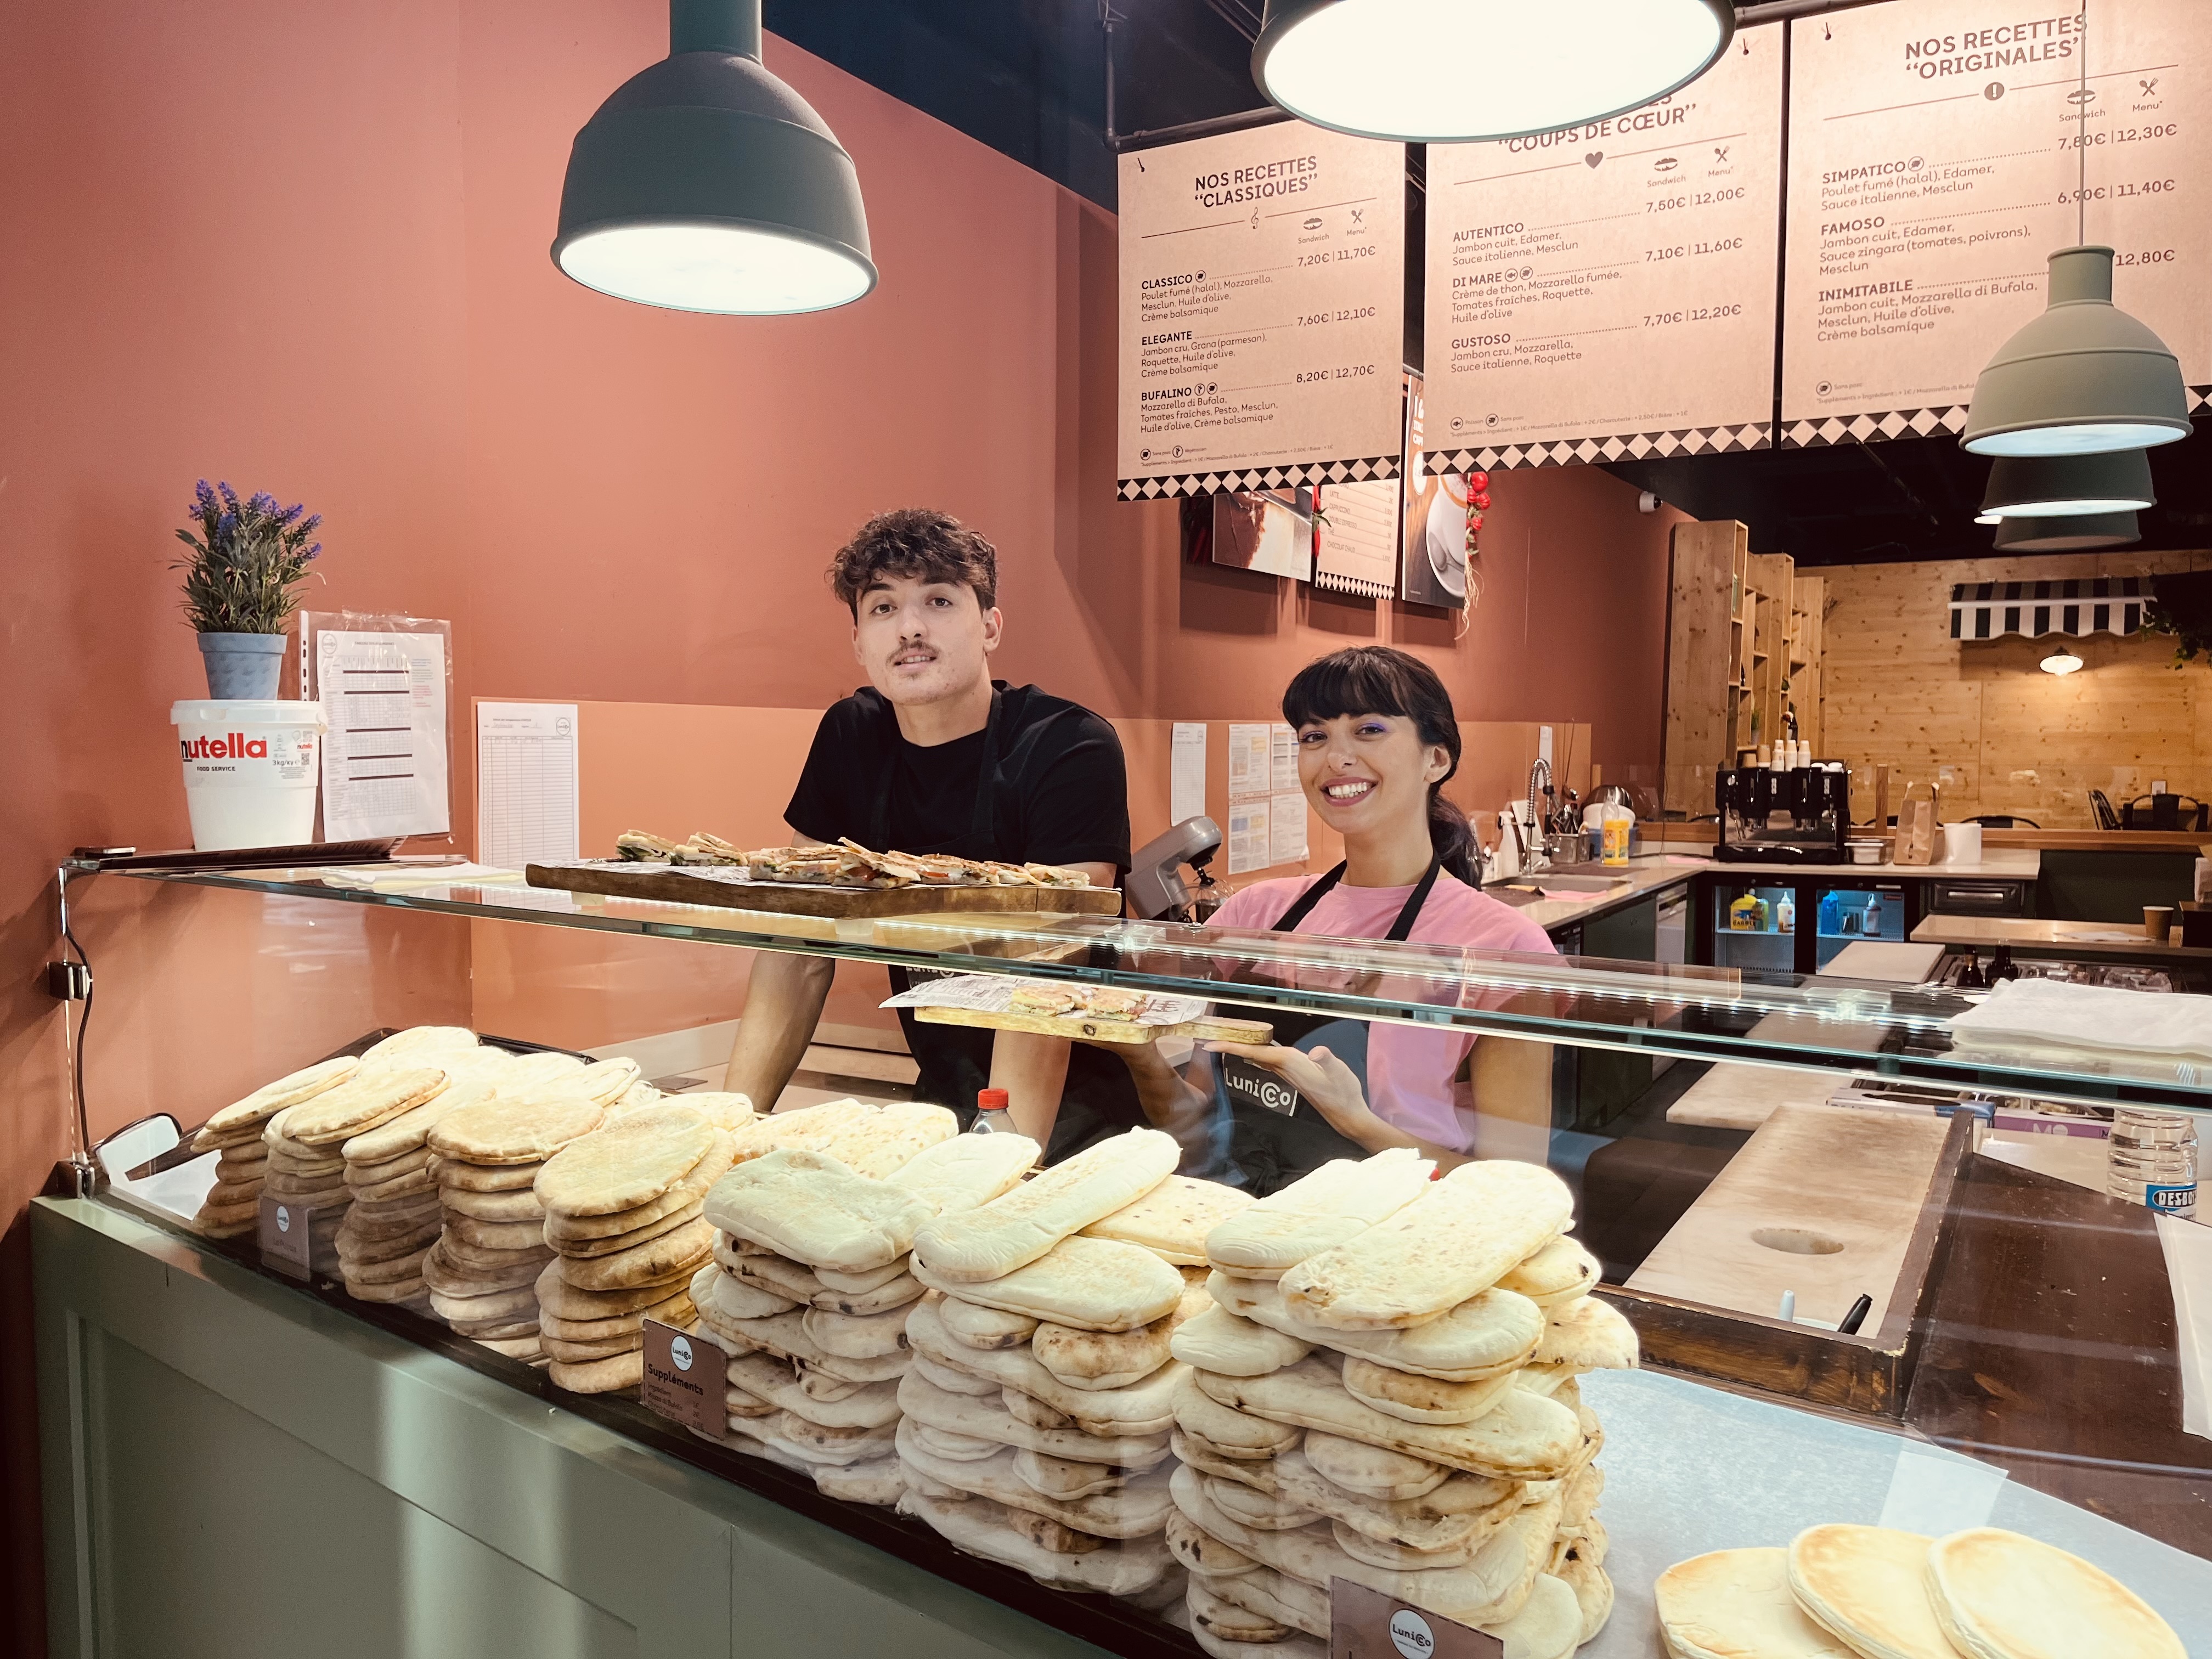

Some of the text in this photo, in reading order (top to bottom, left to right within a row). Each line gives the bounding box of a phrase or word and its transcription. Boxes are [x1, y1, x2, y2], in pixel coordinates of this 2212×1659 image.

[1905, 14, 2087, 60] NOS RECETTES
[1585, 121, 1612, 140] DE
[1617, 105, 1696, 134] CŒUR”
[1822, 123, 2177, 184] SIMPATICO 7,80€ 12,30€
[1195, 155, 1317, 191] NOS RECETTES
[1647, 174, 1686, 188] Sandwich
[1821, 165, 1995, 198] Poulet fumé (halal), Edamer,
[1194, 173, 1318, 208] “CLASSIQUES”
[1821, 180, 1973, 211] Sauce italienne, Mesclun
[1453, 187, 1745, 242] AUTENTICO 7,50€ 12,00€
[1821, 179, 2175, 236] FAMOSO 6,90€ 11,40€
[1297, 233, 1330, 245] Sandwich
[1452, 232, 1562, 255] Jambon cuit, Edamer,
[1820, 223, 1955, 250] Jambon cuit, Edamer,
[1820, 225, 2031, 263] Sauce zingara (tomates, poivrons),
[1452, 241, 1578, 266] Sauce italienne, Mesclun
[1453, 237, 1743, 289] DI MARE 7,10€ 11,60€
[1141, 245, 1376, 290] CLASSICO 7,20€ 11,70€
[1818, 249, 2175, 302] INIMITABILE 12,80€
[1819, 261, 1869, 276] Mesclun
[1141, 274, 1273, 301] Poulet fumé (halal), Mozzarella,
[1452, 270, 1622, 300] Crème de thon, Mozzarella fumée,
[1818, 280, 2038, 315] Jambon cuit, Mozzarella di Bufala,
[1141, 300, 1177, 312] Mesclun,
[1178, 296, 1201, 306] Huile
[1451, 287, 1593, 312] Tomates fraîches, Roquette,
[1141, 306, 1218, 323] Crème balsamique
[1141, 306, 1375, 346] ELEGANTE 7,60€ 12,10€
[1451, 304, 1741, 349] GUSTOSO 7,70€ 12,20€
[1452, 312, 1479, 324] Huile
[1818, 314, 1871, 329] Mesclun,
[1874, 308, 1908, 323] Huile
[1141, 346, 1173, 357] Jambon
[1190, 341, 1216, 351] Grana
[1217, 332, 1267, 349] (parmesan),
[1817, 320, 1935, 342] Crème balsamique
[1141, 356, 1181, 368] Roquette,
[1182, 352, 1205, 362] Huile
[1451, 339, 1573, 362] Jambon cru, Mozzarella,
[1451, 351, 1582, 373] Sauce italienne, Roquette
[1141, 363, 1218, 378] Crème balsamique
[1141, 364, 1375, 402] BUFALINO 8,20€ 12,70€
[1141, 395, 1227, 412] Mozzarella di Bufala,
[1141, 413, 1175, 422] Tomates
[1214, 406, 1239, 415] Pesto,
[1241, 401, 1278, 412] Mesclun,
[1141, 423, 1163, 433] Huile
[1194, 419, 1222, 428] Crème
[1223, 413, 1273, 425] balsamique
[181, 732, 267, 759] nutella
[647, 1363, 704, 1396] Suppléments
